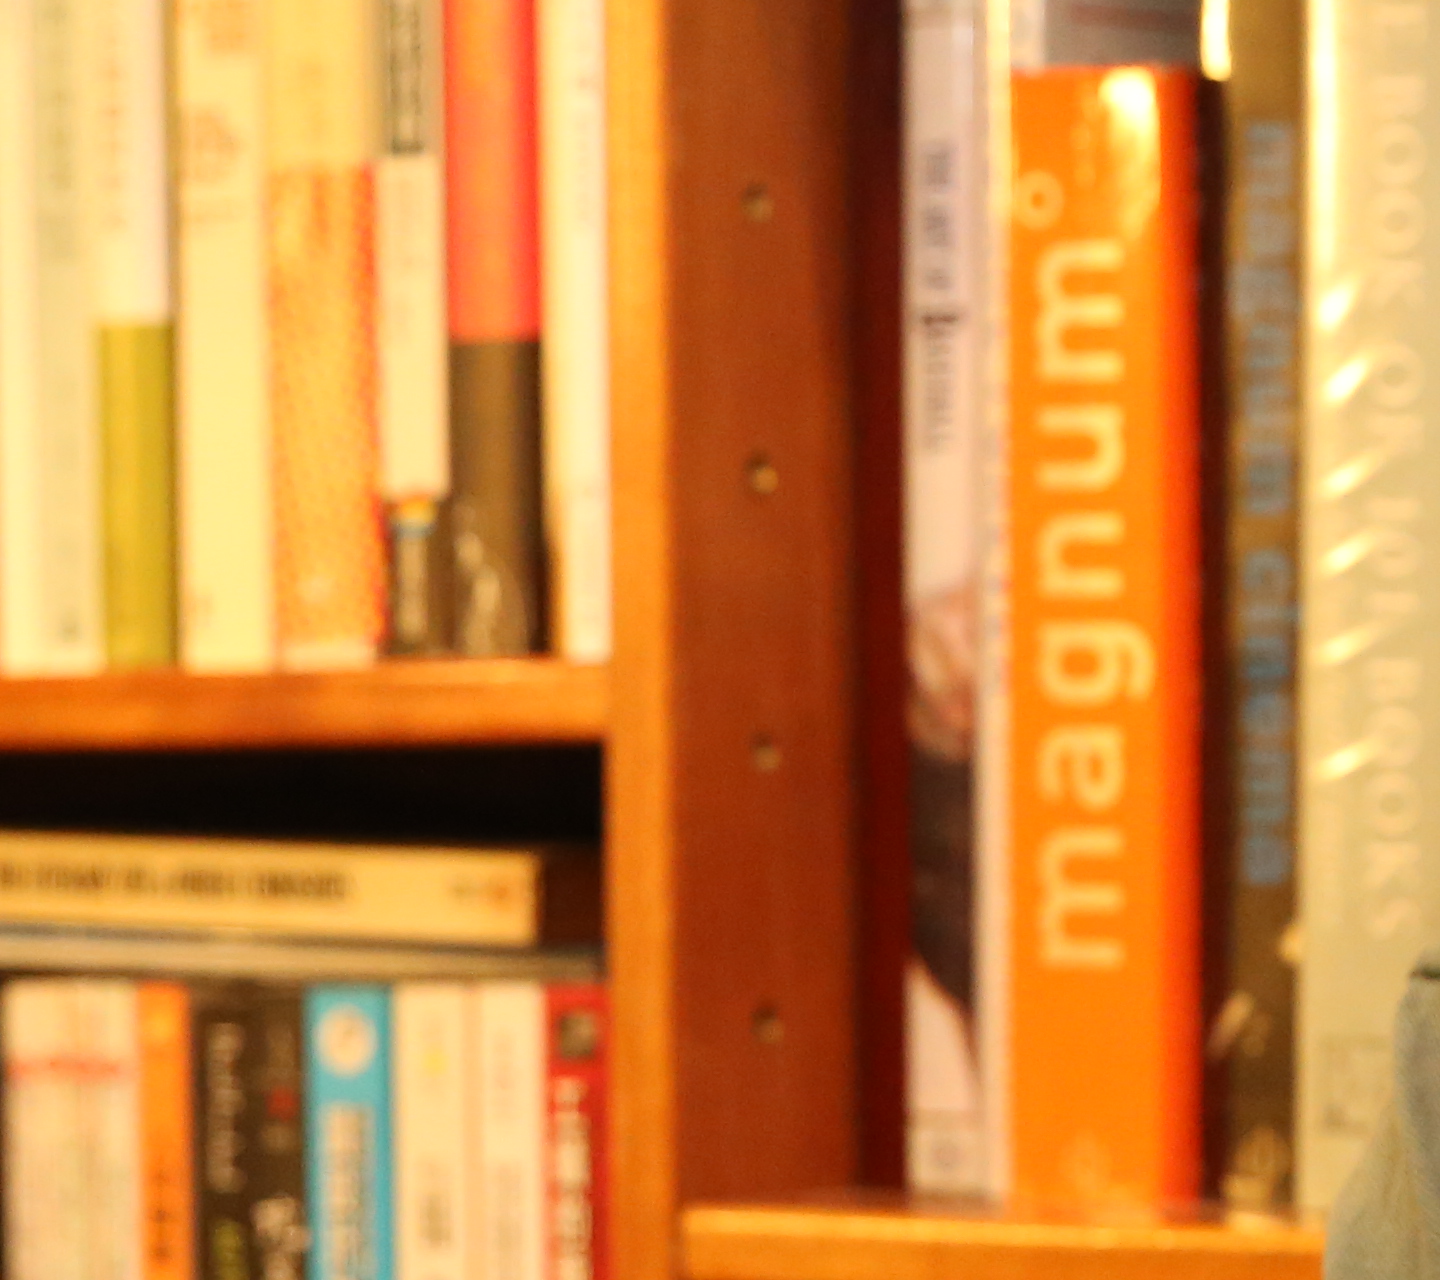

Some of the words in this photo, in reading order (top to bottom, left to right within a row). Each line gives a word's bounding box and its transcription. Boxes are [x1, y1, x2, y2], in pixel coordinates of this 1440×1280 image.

[1363, 73, 1427, 304] BOOK
[1361, 340, 1424, 450] OF
[1362, 656, 1424, 942] BOOKS
